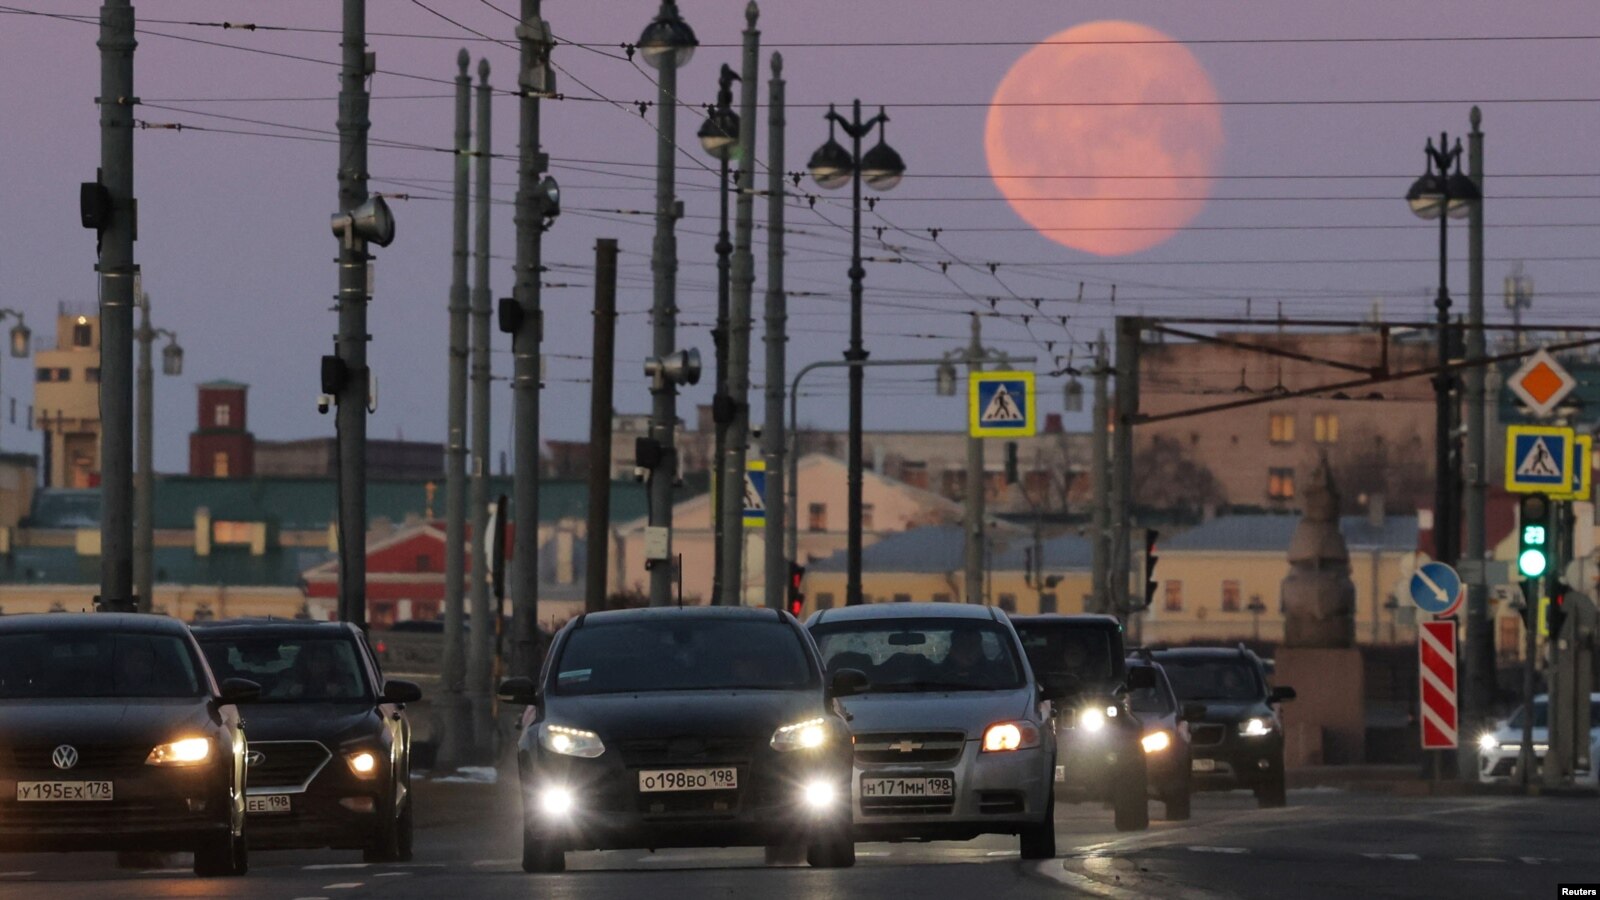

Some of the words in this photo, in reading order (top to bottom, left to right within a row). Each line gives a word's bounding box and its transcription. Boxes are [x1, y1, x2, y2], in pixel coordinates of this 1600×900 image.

[710, 770, 733, 782] 198
[86, 782, 109, 794] 178
[928, 779, 950, 790] 198
[268, 796, 288, 807] 198
